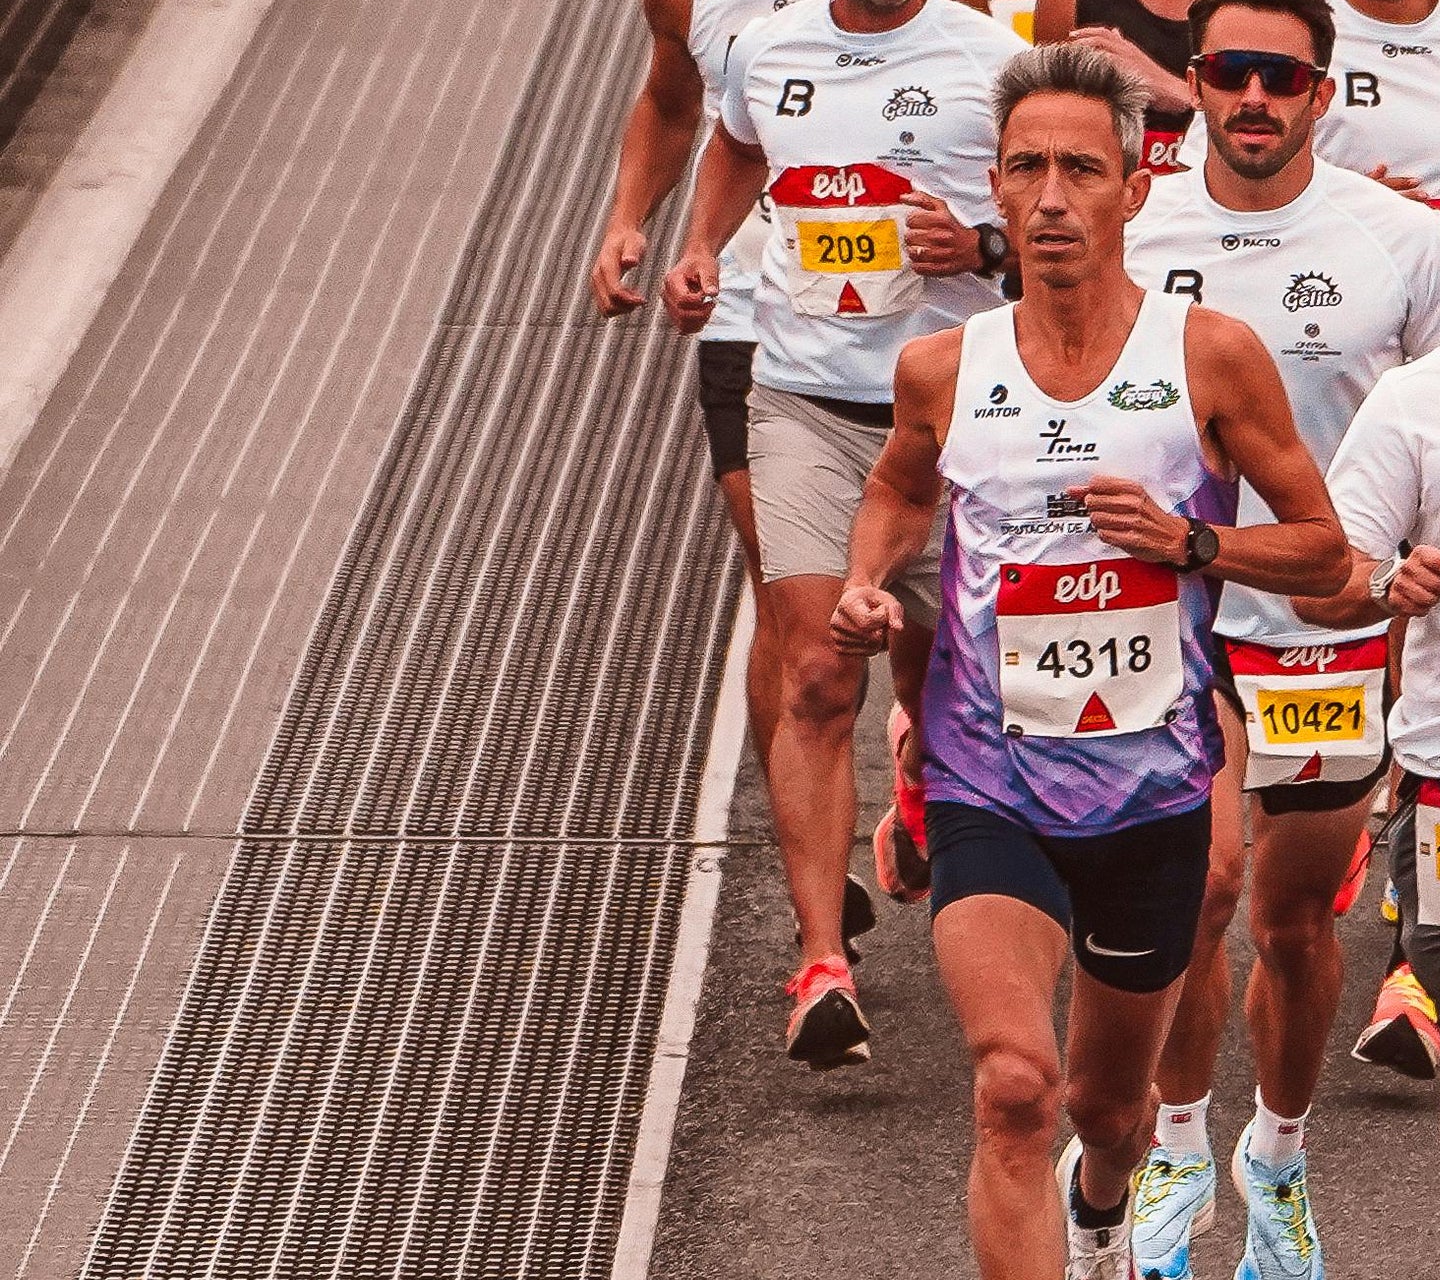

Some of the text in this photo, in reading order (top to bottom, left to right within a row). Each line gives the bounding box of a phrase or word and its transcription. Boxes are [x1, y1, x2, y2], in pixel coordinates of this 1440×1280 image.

[776, 78, 815, 117] B
[1344, 71, 1381, 107] B
[882, 100, 938, 121] Gelito
[1148, 135, 1183, 167] ed
[810, 167, 867, 206] edp
[816, 233, 876, 265] 209
[1242, 238, 1281, 248] PACTO
[1282, 288, 1343, 312] Gelito
[973, 406, 1022, 419] VIATOR
[1053, 563, 1122, 610] edp
[1036, 634, 1152, 679] 4318
[1262, 699, 1361, 735] 10421
